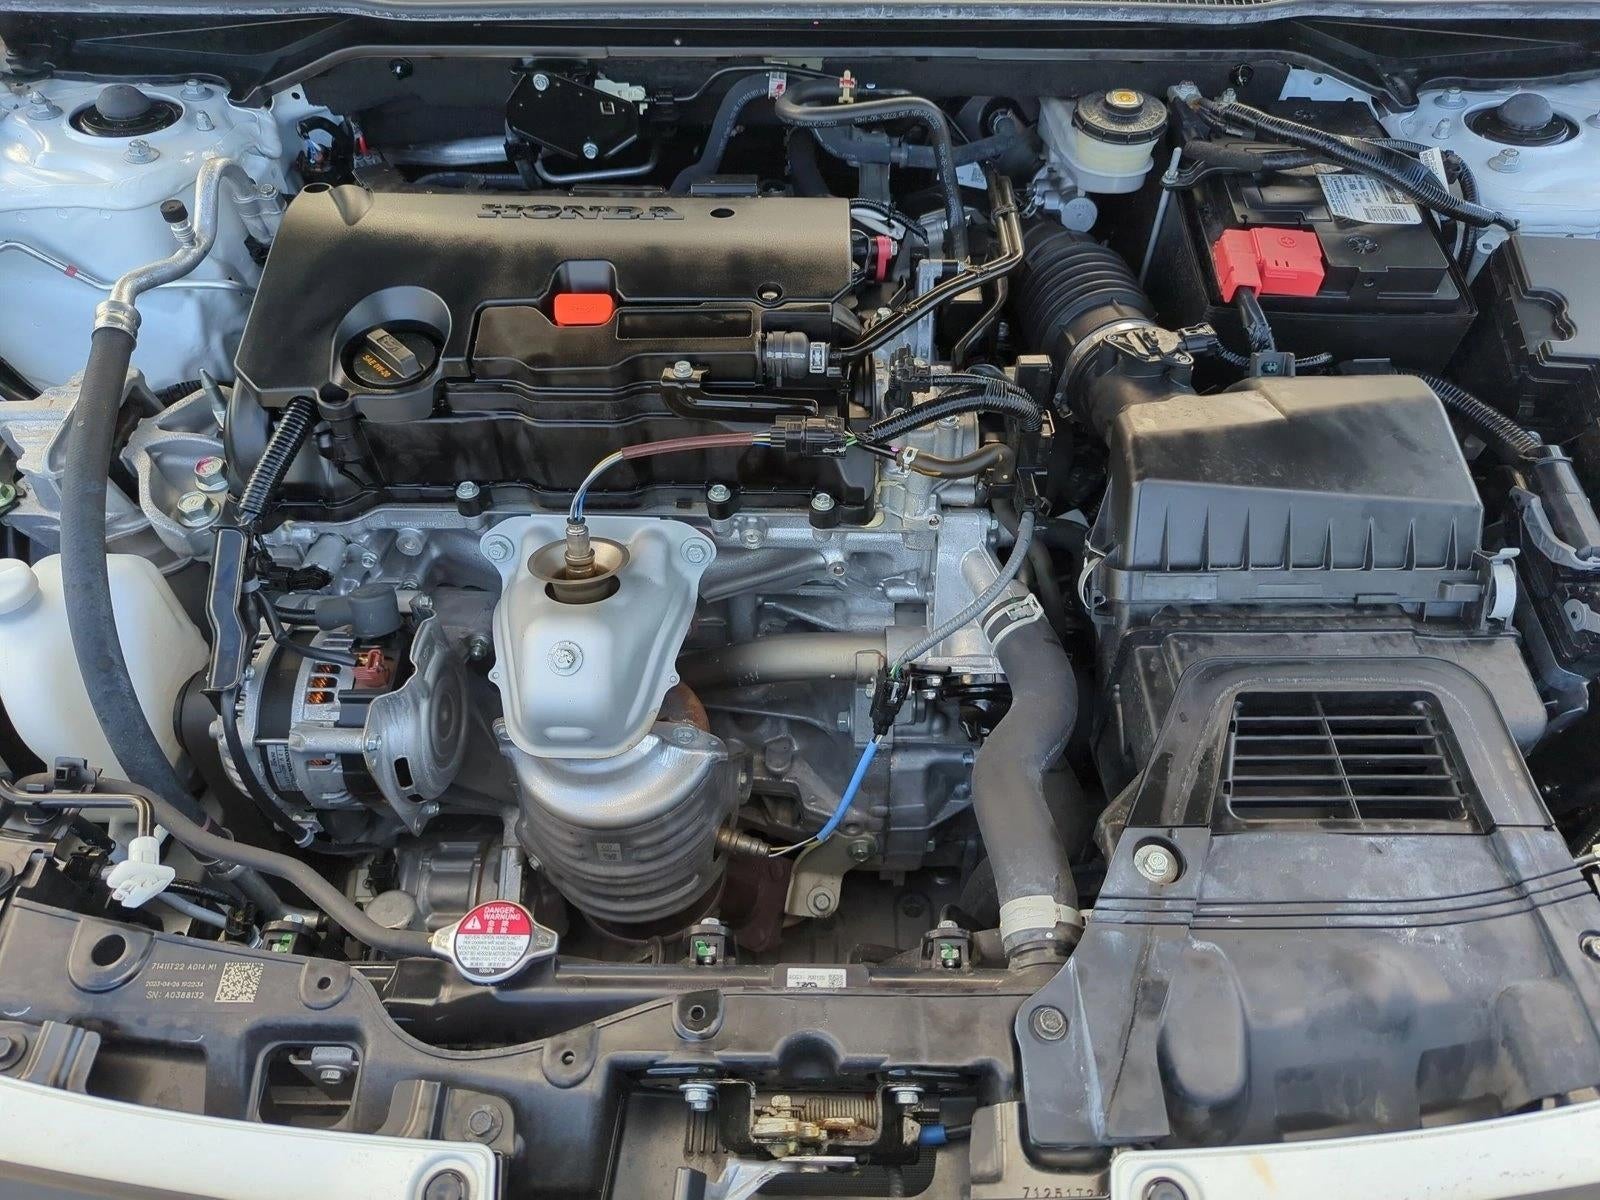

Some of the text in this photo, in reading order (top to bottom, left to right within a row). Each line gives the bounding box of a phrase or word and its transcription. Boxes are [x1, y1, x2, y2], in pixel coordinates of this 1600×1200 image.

[477, 203, 684, 220] HONDA
[362, 354, 376, 365] SAE
[164, 990, 205, 999] A0388132
